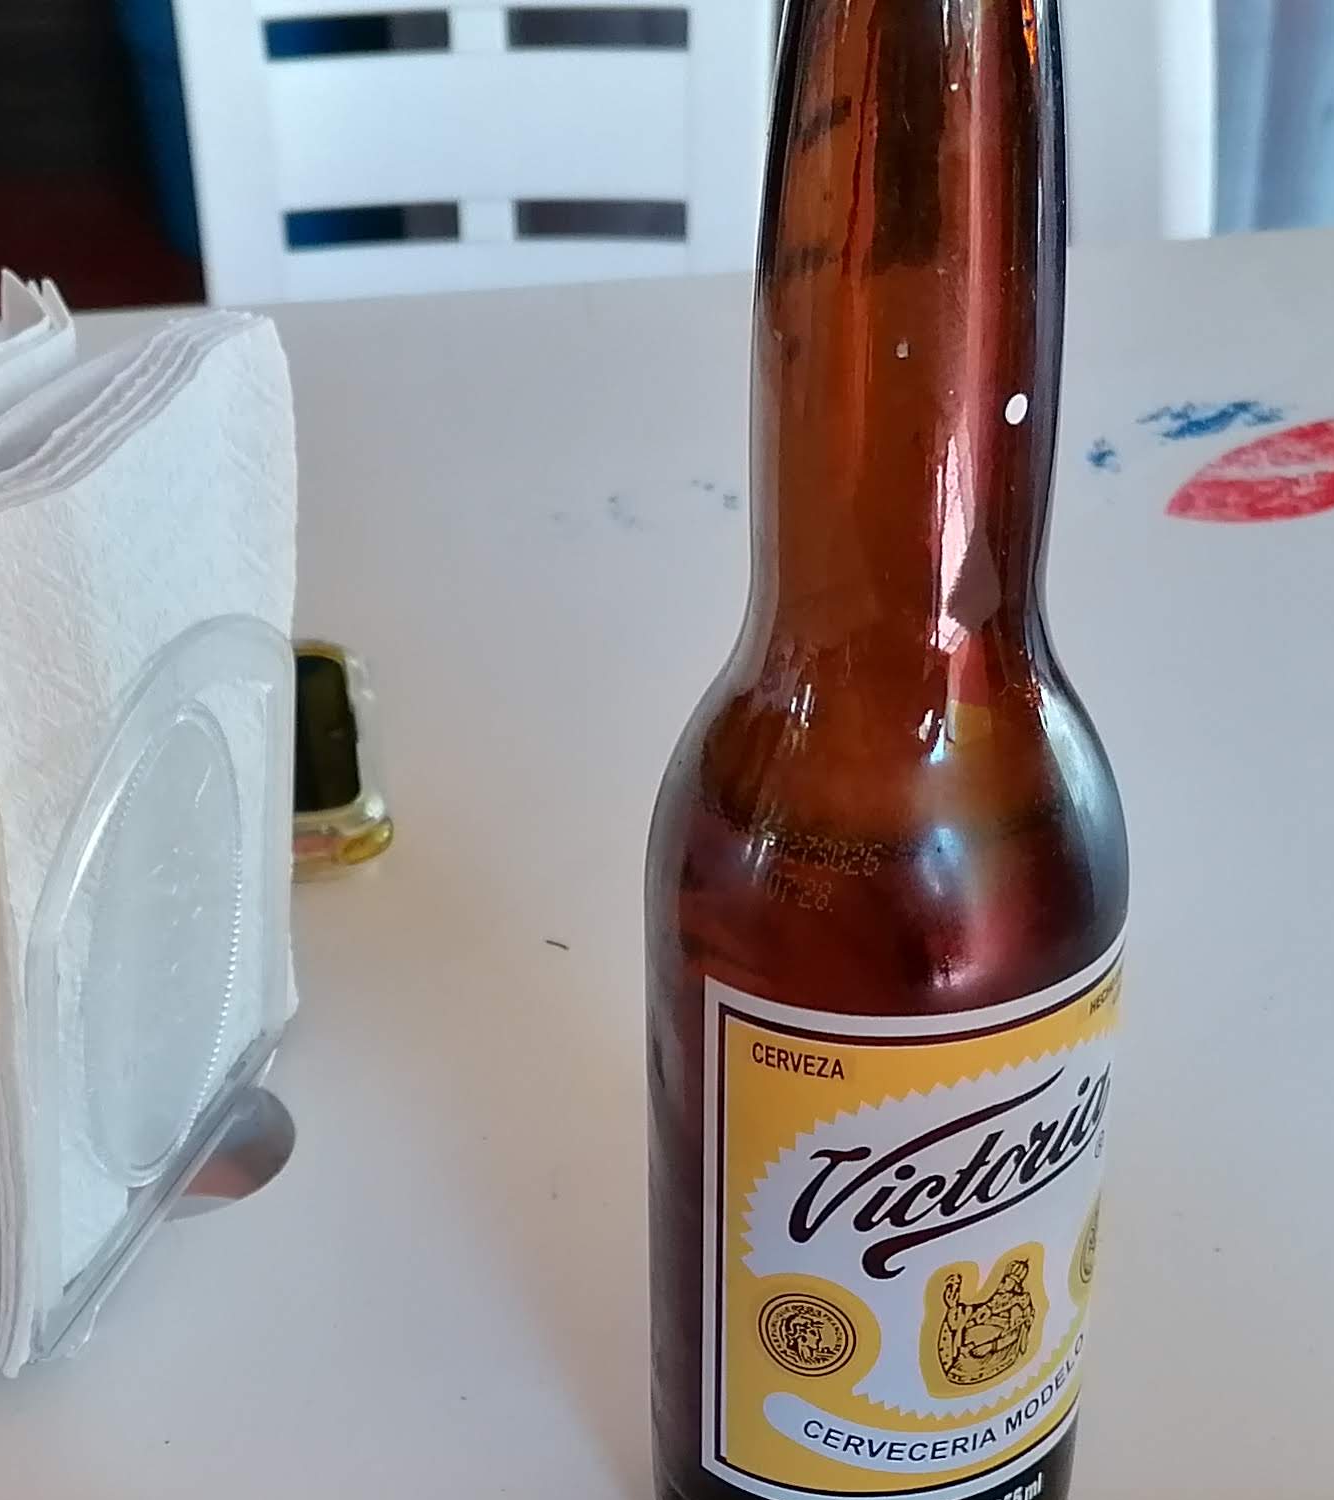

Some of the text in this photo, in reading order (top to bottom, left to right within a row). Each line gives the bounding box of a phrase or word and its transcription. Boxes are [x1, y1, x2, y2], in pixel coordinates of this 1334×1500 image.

[752, 1041, 845, 1080] CERVEZA
[788, 1061, 1110, 1281] Victoria
[803, 1333, 1084, 1462] CERVECERIA MODELO
